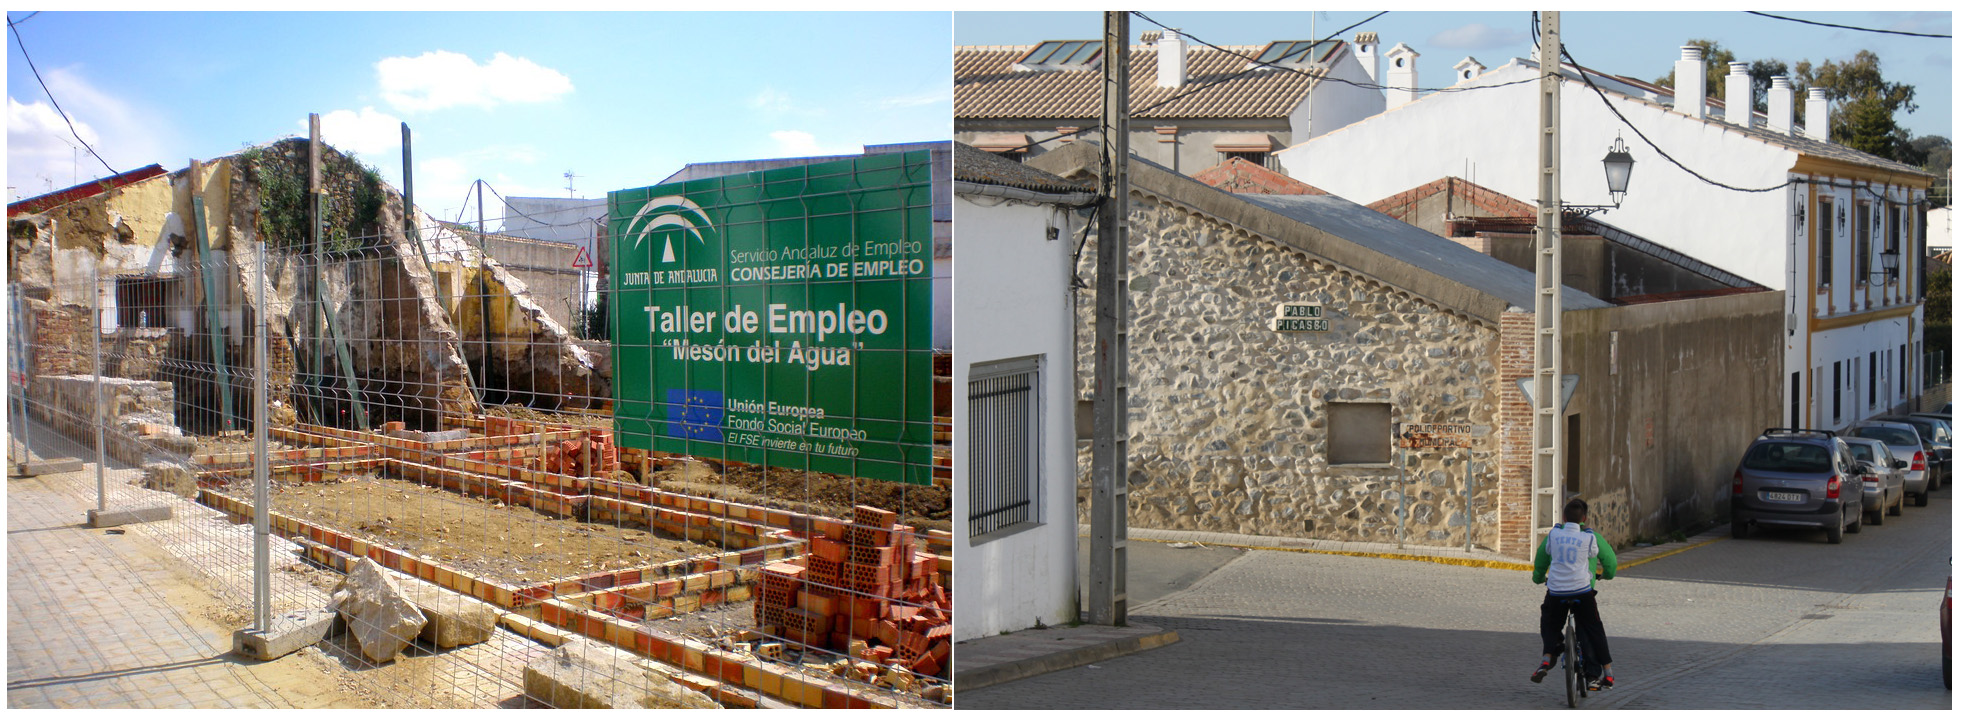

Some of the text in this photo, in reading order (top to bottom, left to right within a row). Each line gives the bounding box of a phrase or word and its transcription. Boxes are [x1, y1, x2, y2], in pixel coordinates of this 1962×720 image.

[731, 238, 922, 264] Servicio Andaluz de Empleo
[623, 272, 650, 286] JUNTA
[654, 271, 665, 285] DE
[731, 258, 924, 282] CONSEJERÍA DE EMPLEO
[644, 302, 888, 342] Taller de Empleo
[1284, 306, 1320, 317] PABLO
[747, 340, 780, 364] del
[728, 398, 825, 421] Unión Europea
[728, 414, 867, 442] Fondo Social Europeo
[1409, 424, 1471, 434] POLIDEPORTIVO
[739, 434, 760, 446] FSE
[761, 436, 797, 451] invierte
[799, 441, 812, 452] en
[815, 442, 825, 453] tu
[827, 443, 859, 458] futuro
[1557, 545, 1577, 565] 10
